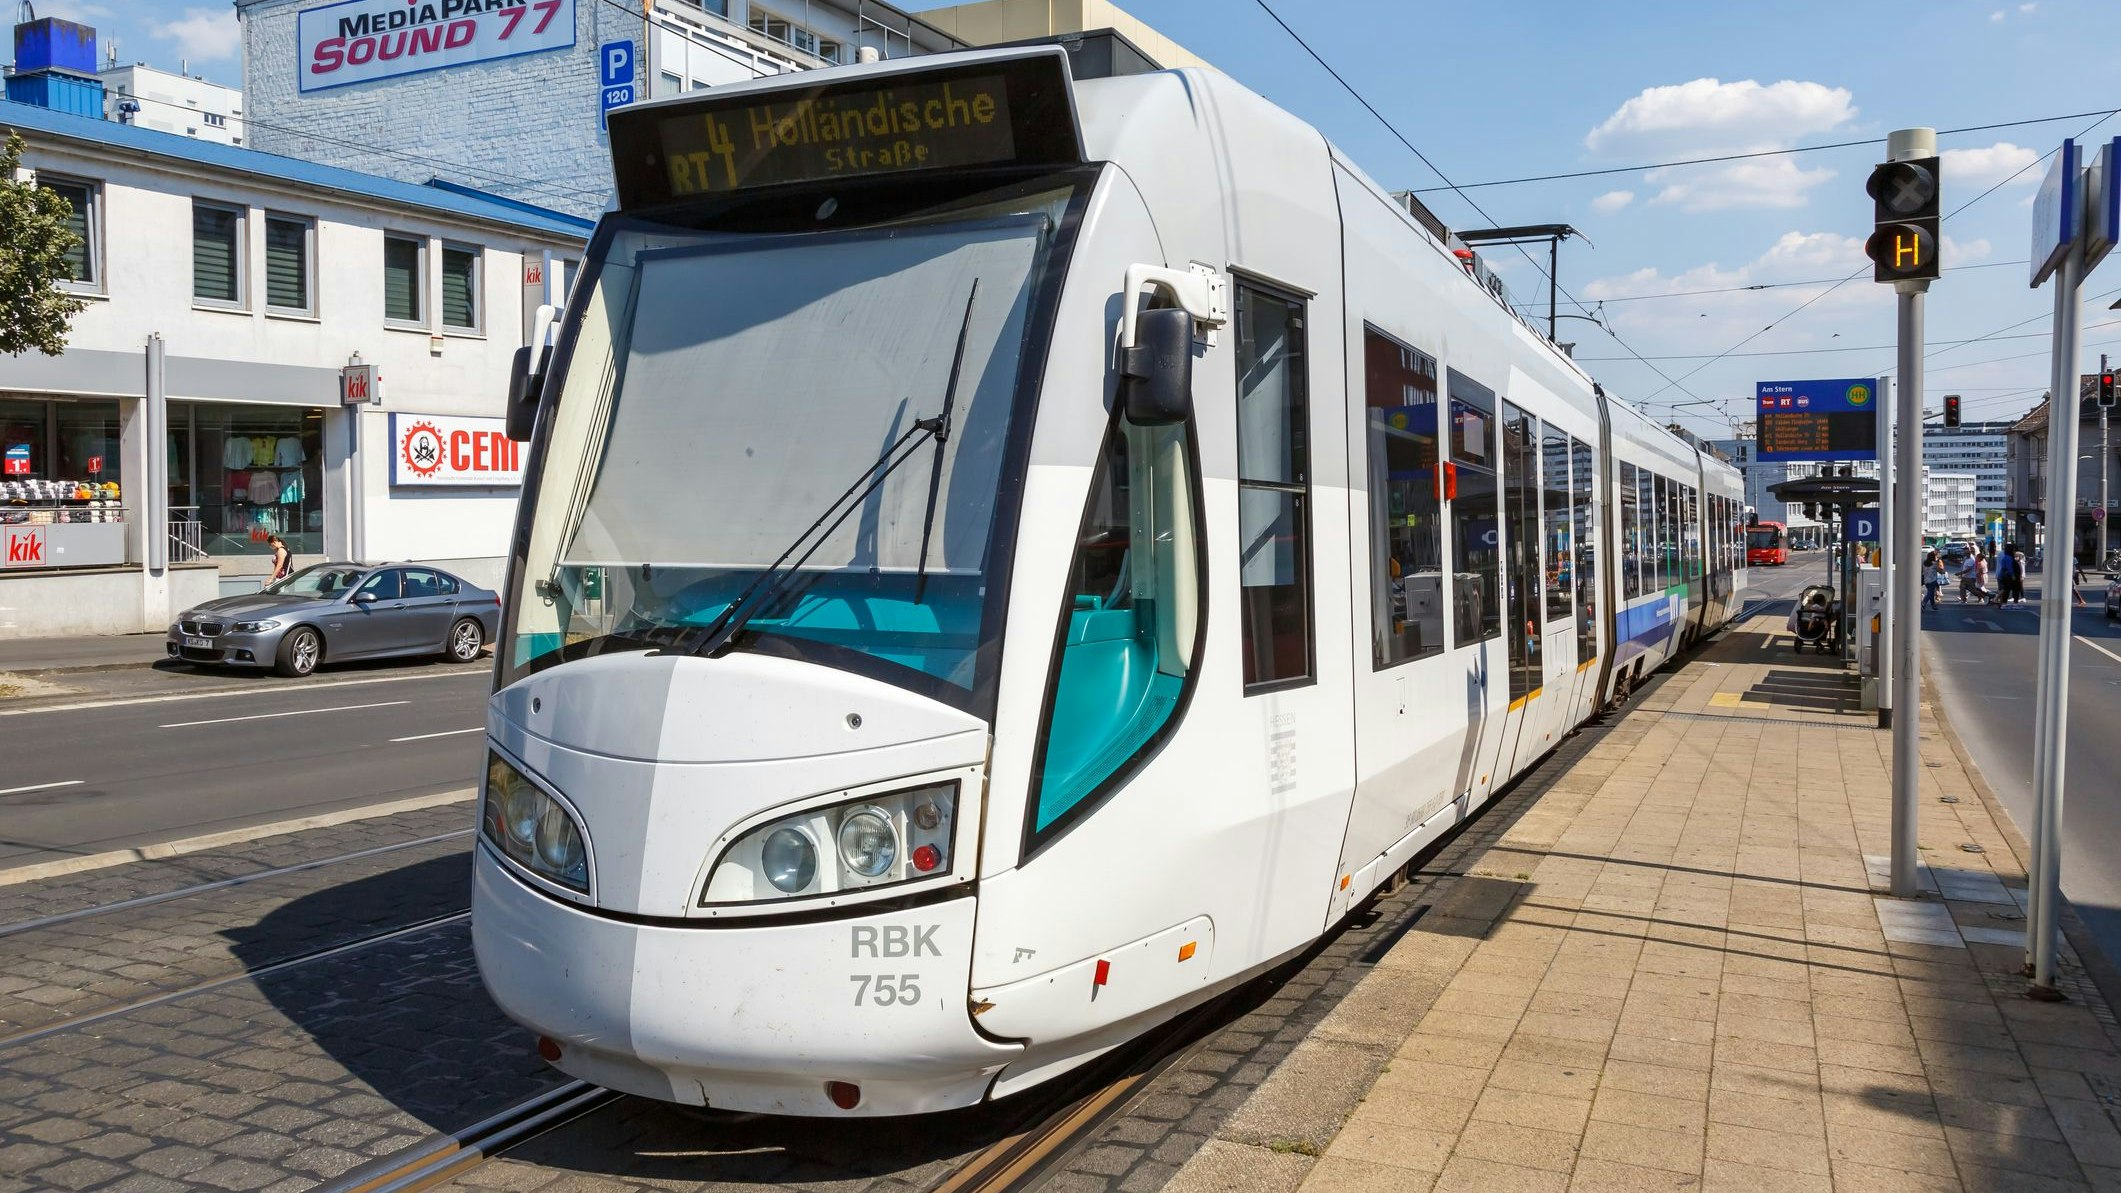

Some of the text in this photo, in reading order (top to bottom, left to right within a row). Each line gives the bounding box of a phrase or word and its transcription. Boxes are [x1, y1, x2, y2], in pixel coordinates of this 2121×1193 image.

[311, 1, 563, 74] SOUND 77
[609, 48, 628, 80] P
[606, 89, 629, 104] 120
[749, 81, 996, 149] Holländische
[826, 140, 928, 171] Straße
[1896, 233, 1919, 267] H
[526, 265, 542, 284] kik
[348, 371, 368, 398] kik
[1774, 385, 1793, 393] Stern
[1780, 398, 1791, 406] RT
[450, 430, 519, 472] CEM
[9, 528, 42, 561] kik
[1858, 520, 1873, 537] D
[851, 924, 943, 958] RBK
[850, 973, 922, 1007] 755
